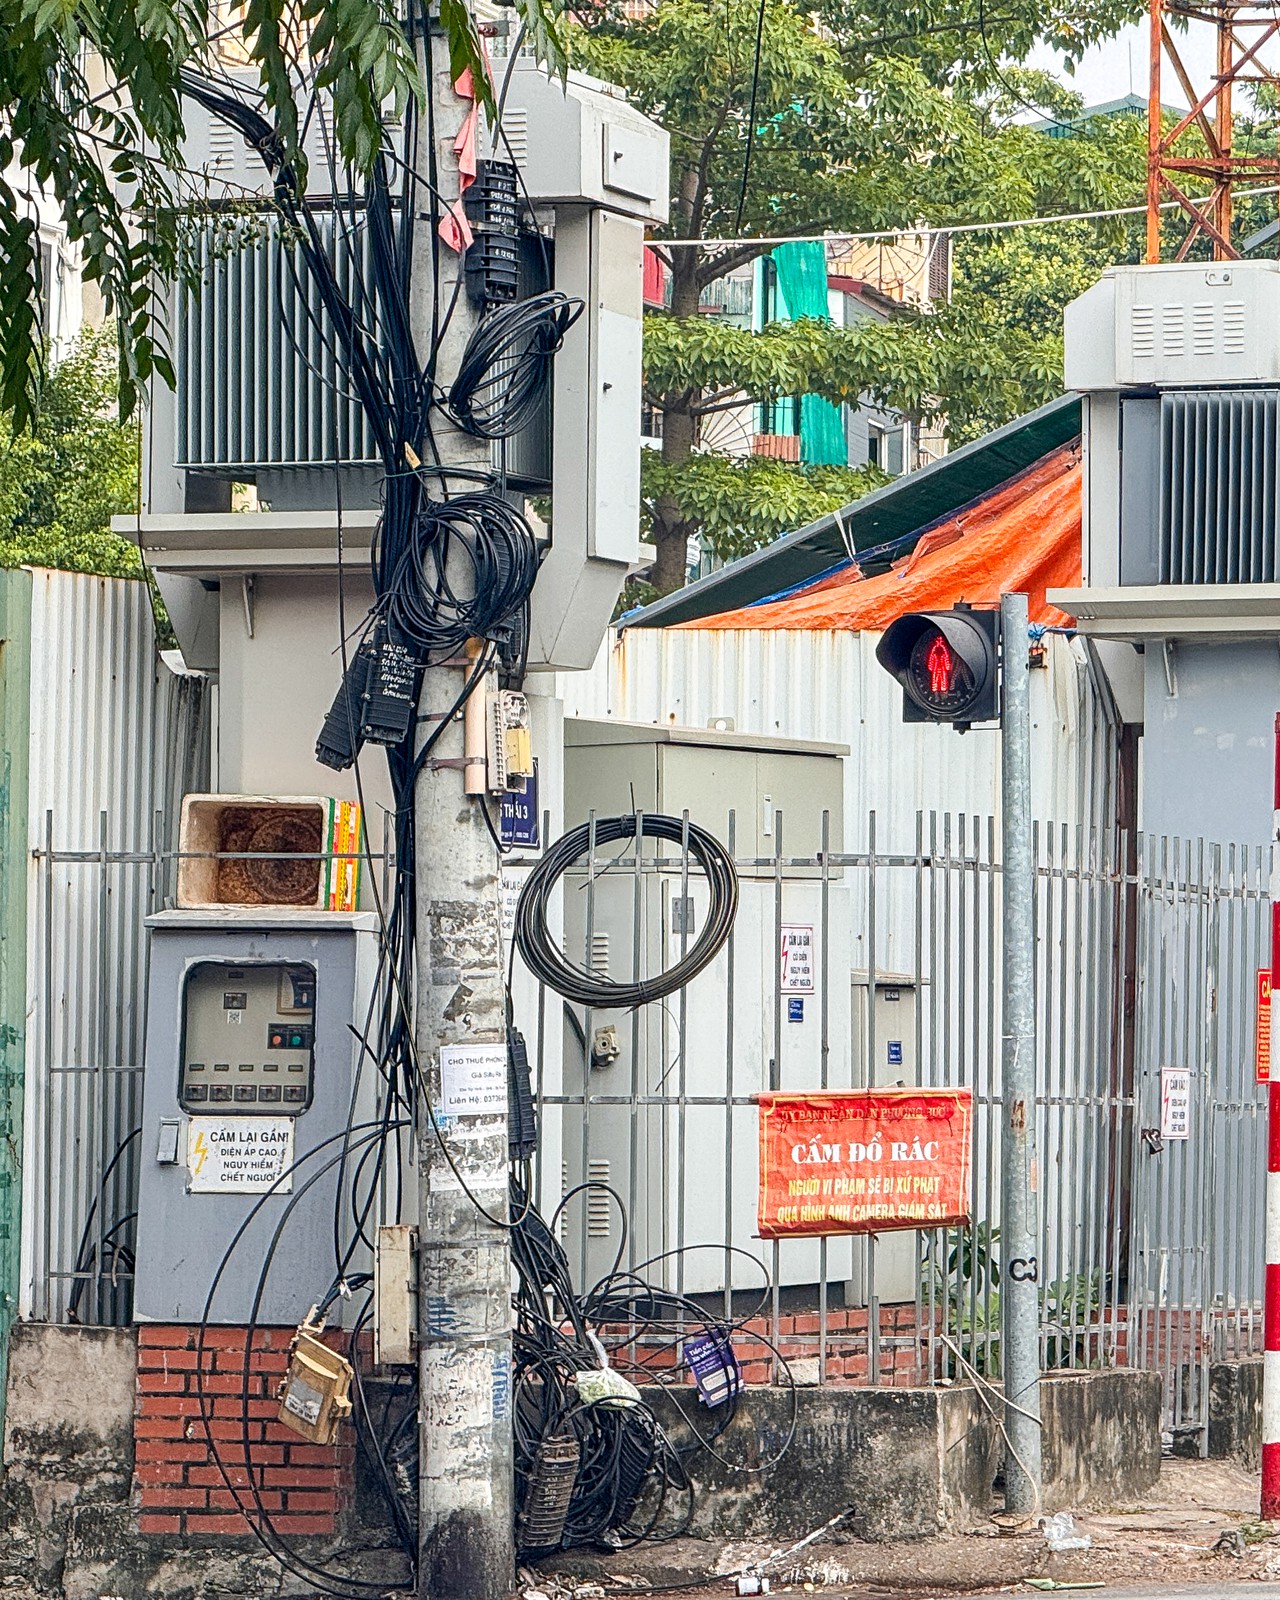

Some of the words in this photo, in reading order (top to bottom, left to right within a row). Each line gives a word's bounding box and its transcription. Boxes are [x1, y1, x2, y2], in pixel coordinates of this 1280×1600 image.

[523, 805, 529, 819] 3
[448, 1058, 464, 1066] CHO
[210, 1127, 236, 1143] CẤM
[258, 1148, 278, 1157] CAO
[791, 1133, 842, 1164] CẤM
[849, 1131, 883, 1162] ĐỔ
[890, 1135, 939, 1161] RÁC
[223, 1160, 249, 1169] NGUY
[220, 1170, 245, 1182] CHẾT
[788, 1175, 820, 1197] NGƯỜI
[823, 1178, 833, 1196] VI
[834, 1177, 865, 1199] PHẠM
[868, 1174, 881, 1195] SẼ
[883, 1176, 894, 1197] BỊ
[914, 1176, 940, 1197] PHẠT
[778, 1204, 798, 1224] QUA
[801, 1202, 826, 1222] HÌNH
[853, 1203, 895, 1222] CAMERA
[898, 1200, 925, 1219] GIÁM
[927, 1200, 948, 1220] SÁT
